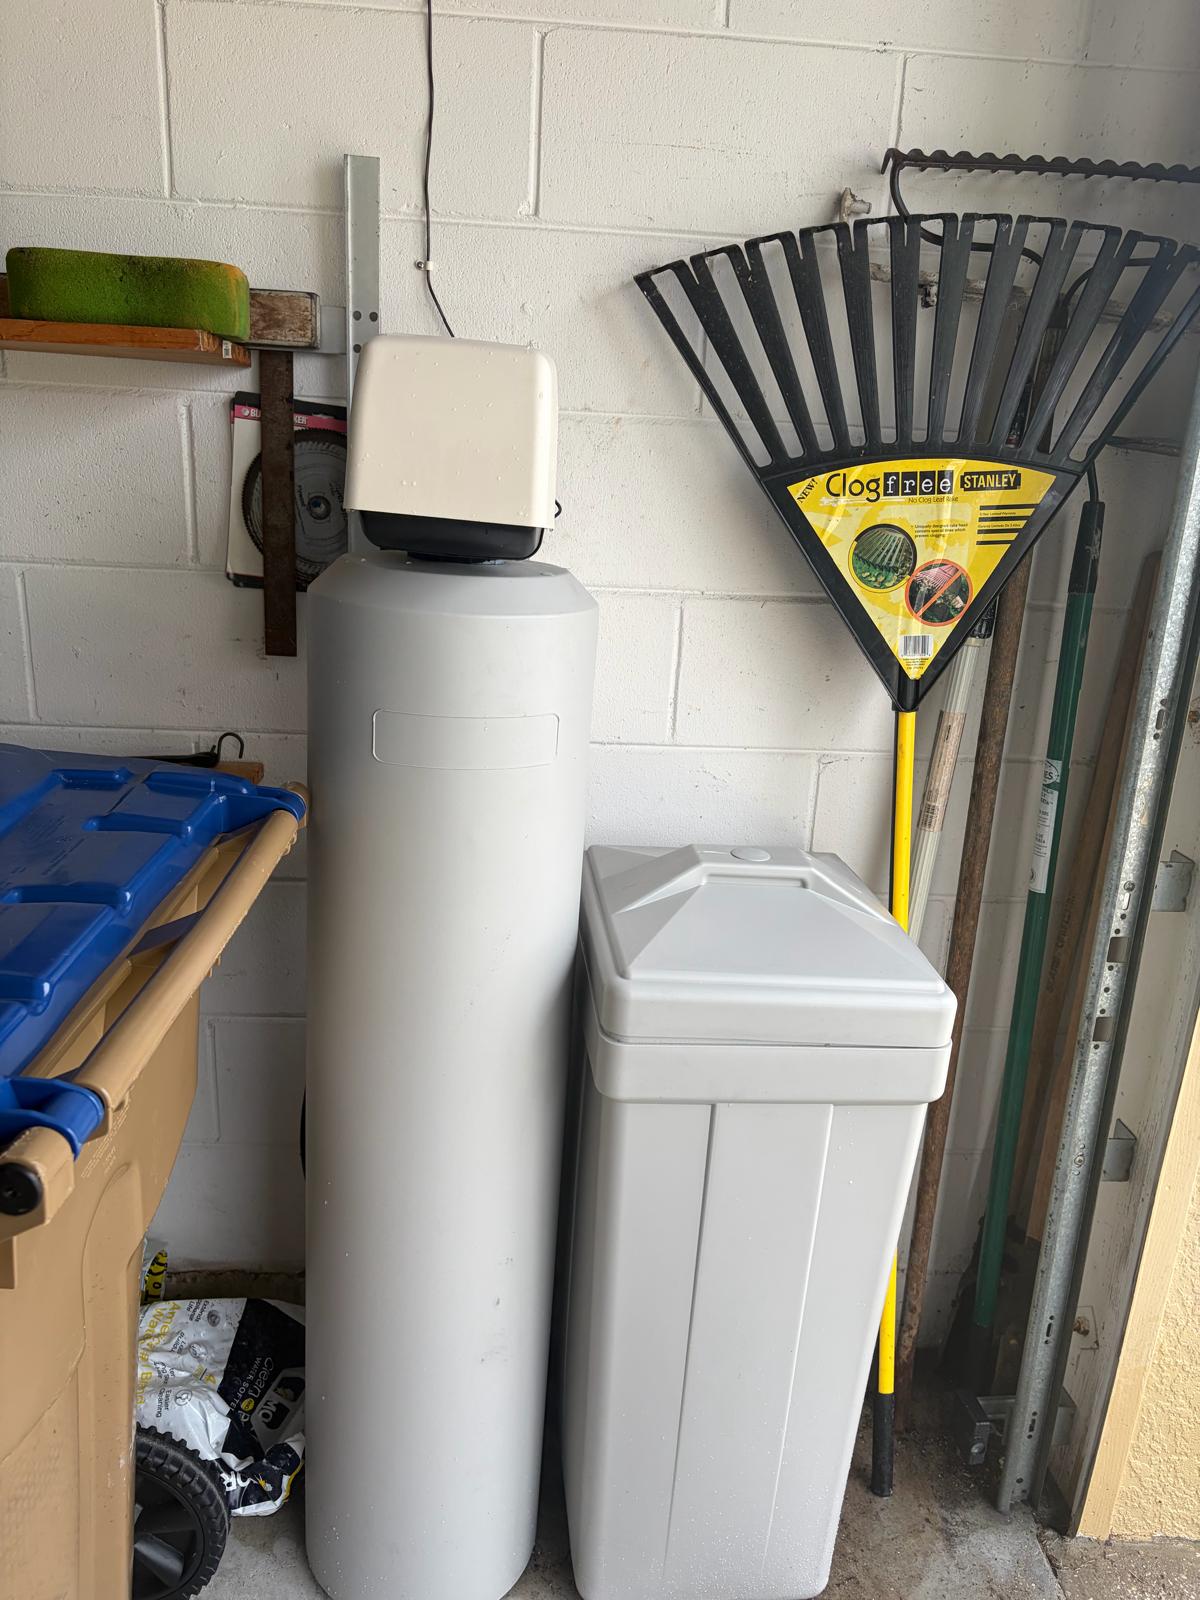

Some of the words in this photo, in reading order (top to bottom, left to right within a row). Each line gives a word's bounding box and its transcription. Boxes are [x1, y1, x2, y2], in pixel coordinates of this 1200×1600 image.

[797, 478, 818, 503] NEW!
[963, 473, 1017, 489] STANLEY
[918, 496, 931, 504] Clog
[933, 495, 945, 503] Leaf
[248, 1357, 274, 1398] Clean
